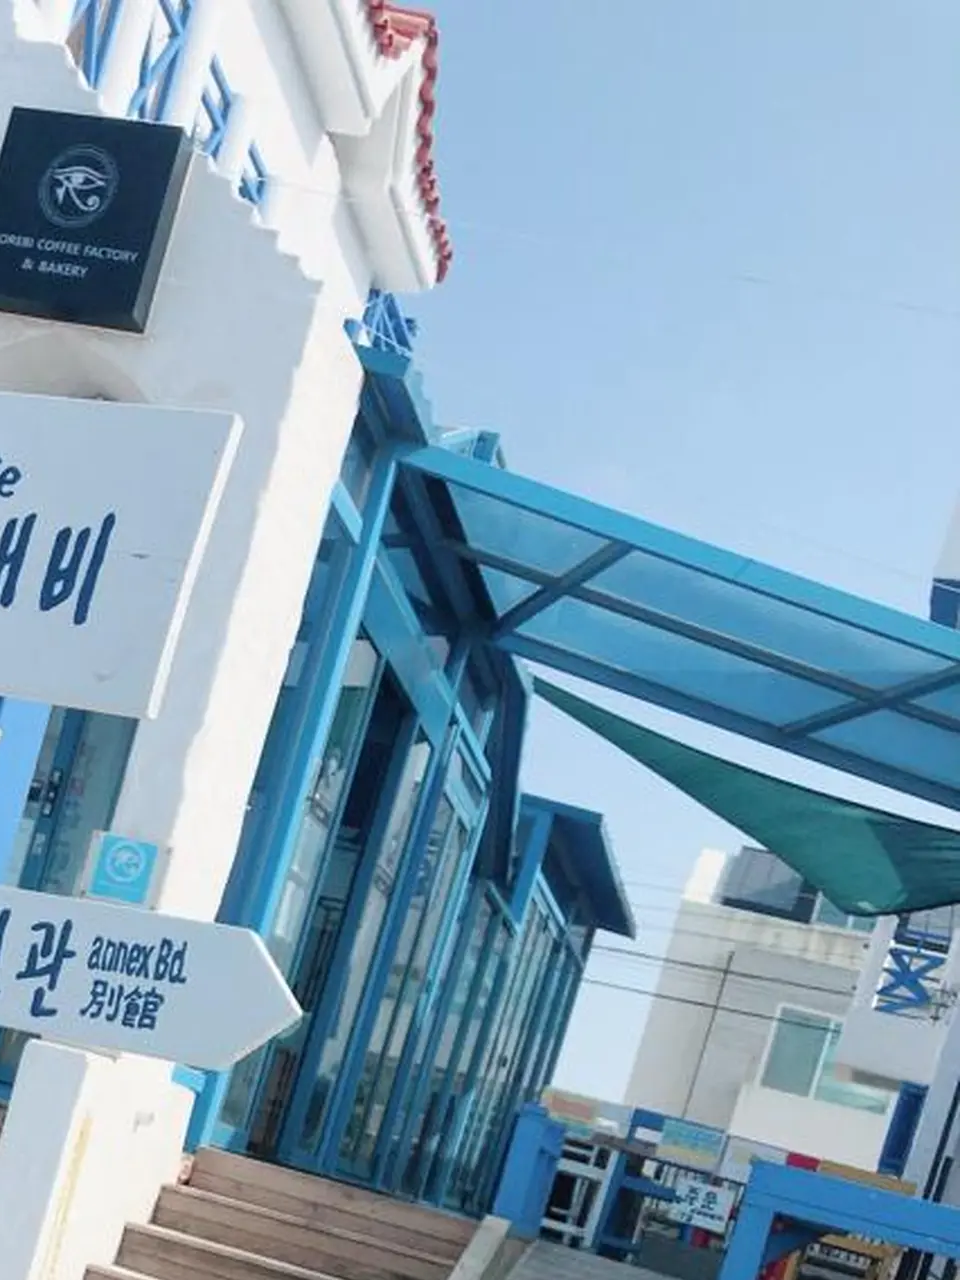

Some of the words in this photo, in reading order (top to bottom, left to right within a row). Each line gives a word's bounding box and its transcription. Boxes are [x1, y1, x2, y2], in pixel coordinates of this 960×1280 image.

[36, 238, 82, 256] COFFEE
[83, 245, 139, 262] FACTORY
[38, 260, 89, 278] BAKERY
